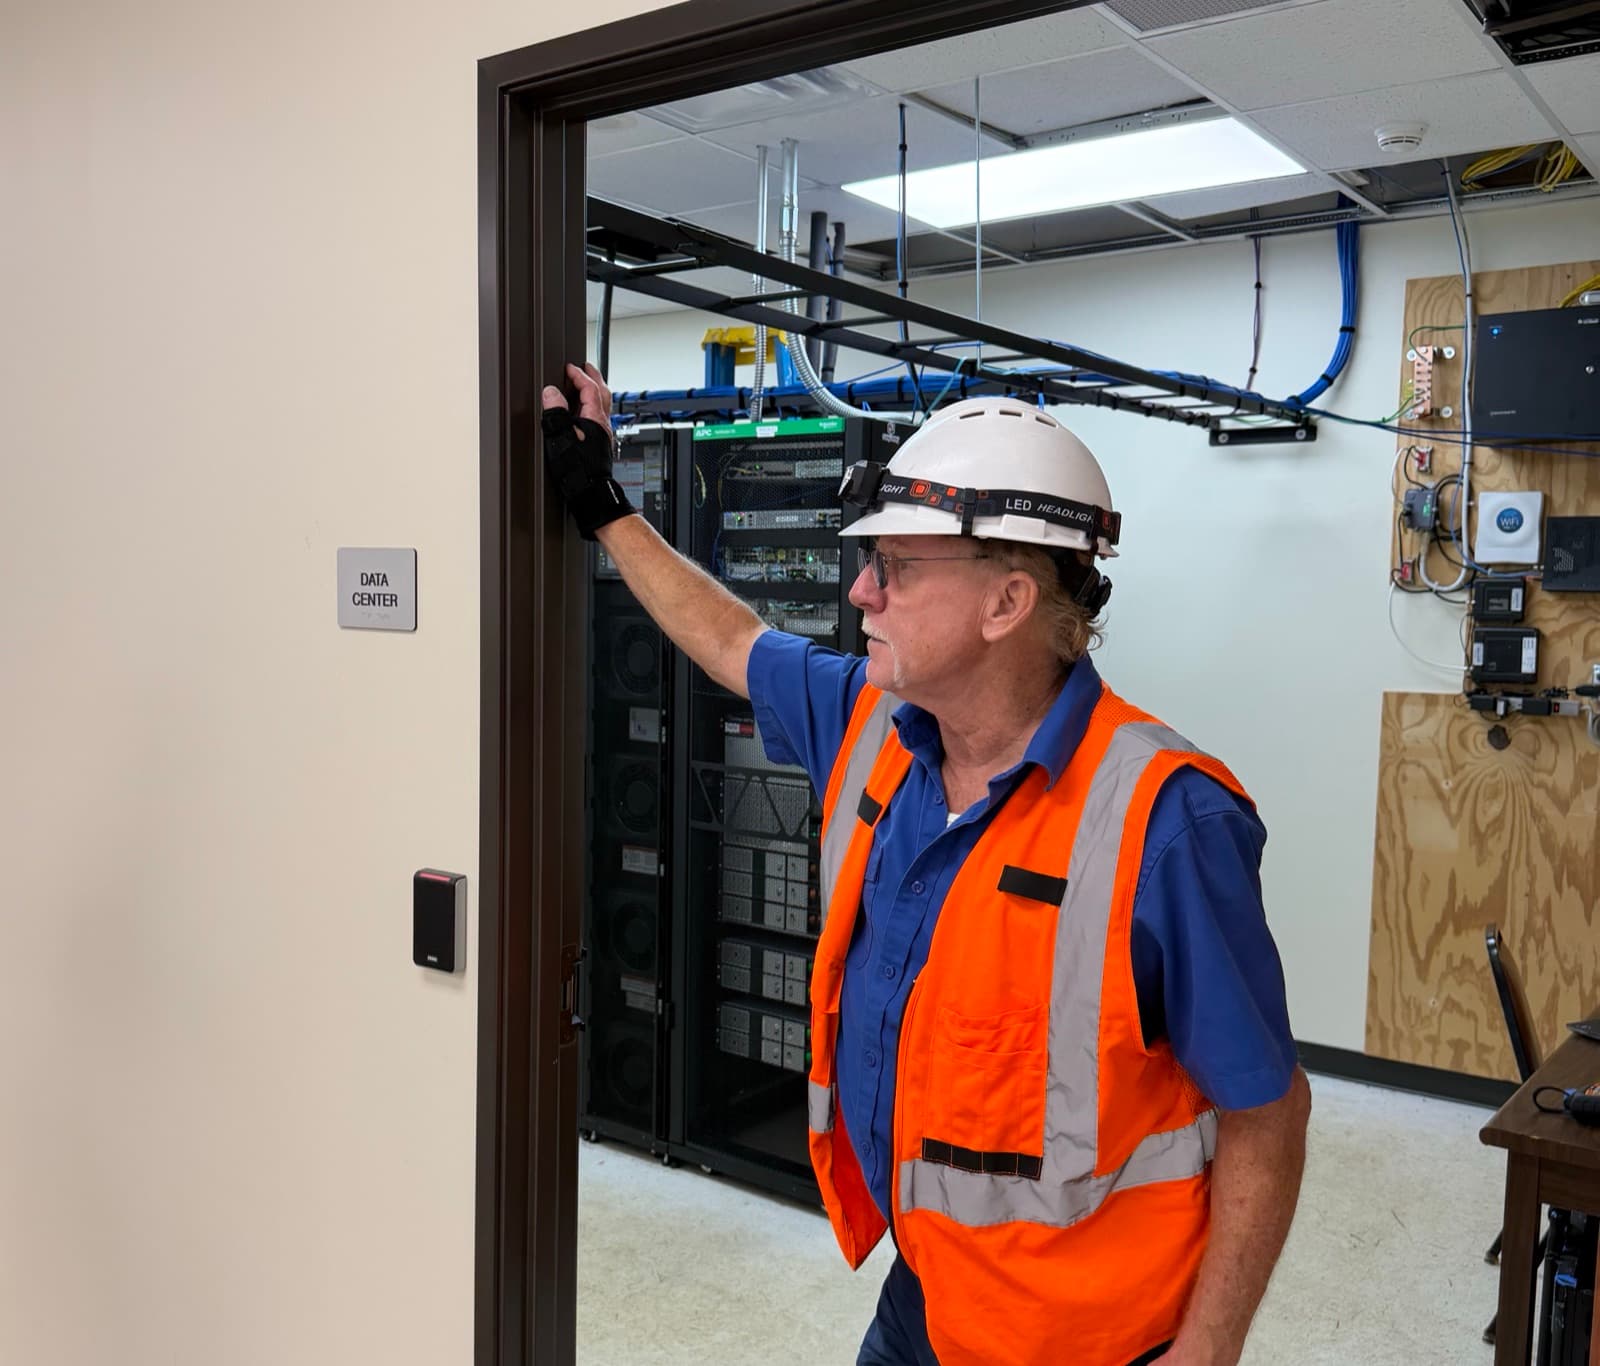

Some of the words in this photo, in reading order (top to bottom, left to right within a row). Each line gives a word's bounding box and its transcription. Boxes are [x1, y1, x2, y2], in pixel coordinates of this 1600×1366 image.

[1005, 498, 1032, 511] LED
[360, 572, 389, 587] DATA
[352, 592, 398, 607] CENTER
